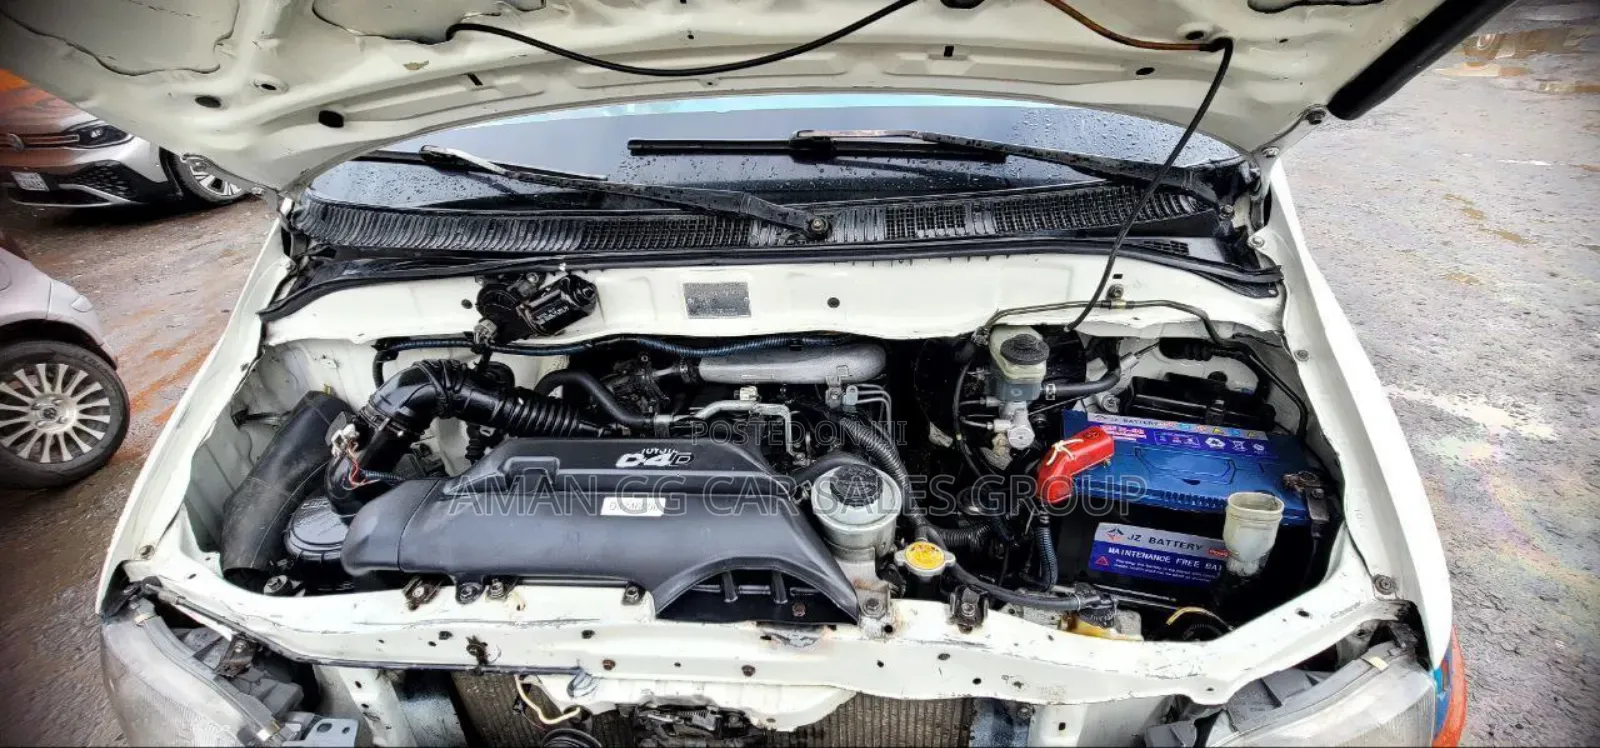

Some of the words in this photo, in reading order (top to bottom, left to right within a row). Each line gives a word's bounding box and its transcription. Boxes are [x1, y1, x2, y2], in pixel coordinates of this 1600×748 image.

[1127, 533, 1142, 543] JZ
[1148, 536, 1204, 551] BATTERY
[1108, 546, 1172, 563] MAINTENANCE
[1175, 557, 1201, 568] FREE
